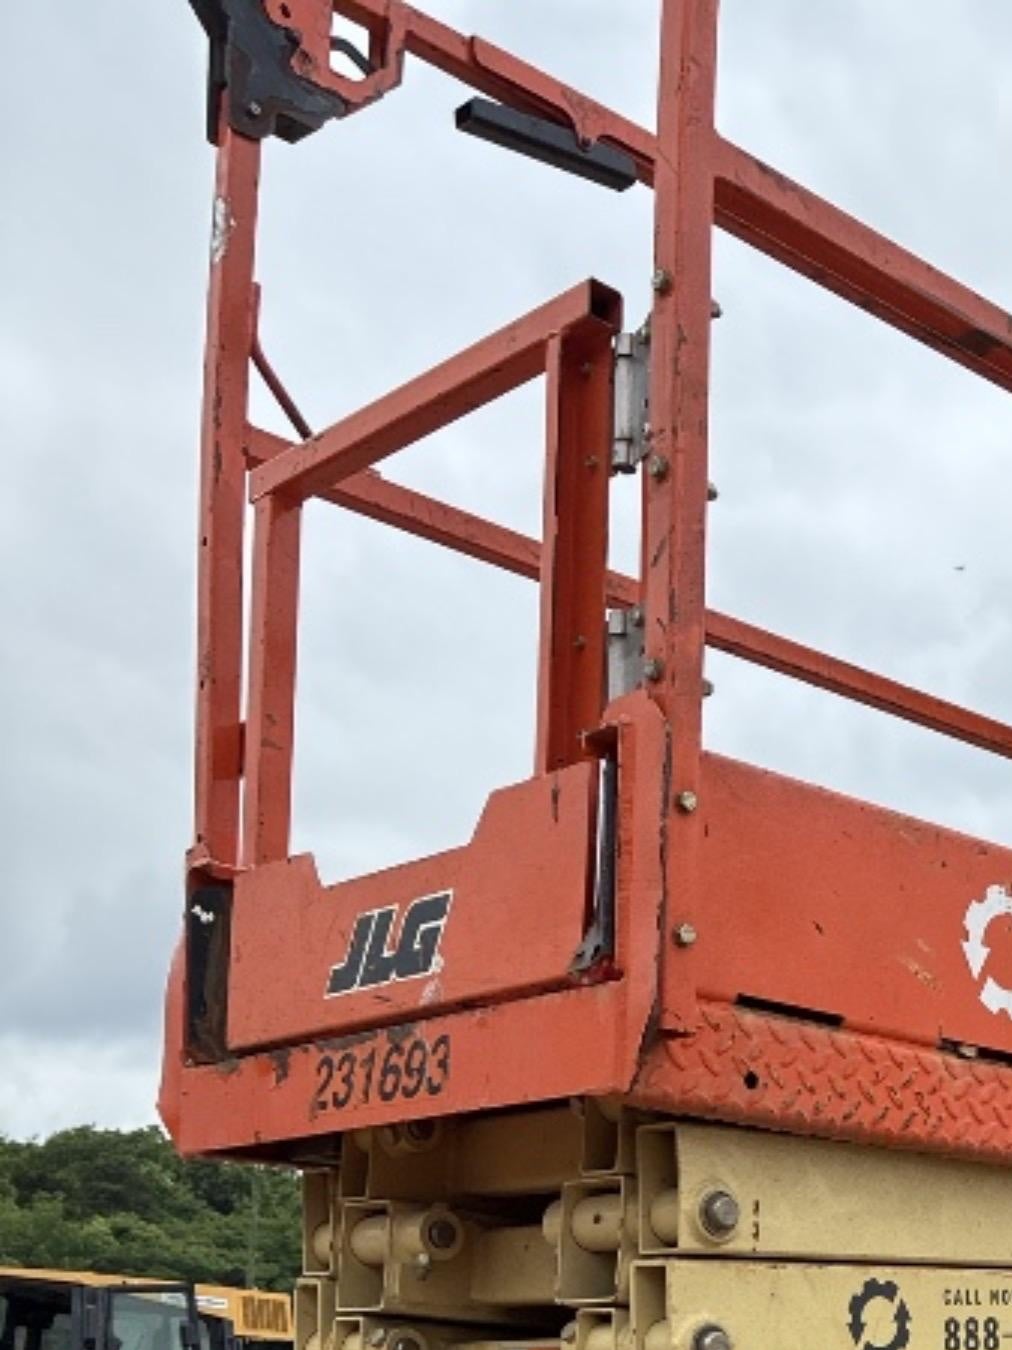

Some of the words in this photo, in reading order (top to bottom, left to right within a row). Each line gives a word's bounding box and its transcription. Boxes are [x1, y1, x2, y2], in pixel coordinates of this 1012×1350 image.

[324, 889, 454, 1000] JLG
[315, 1036, 450, 1112] 231693
[943, 1289, 982, 1305] CALL
